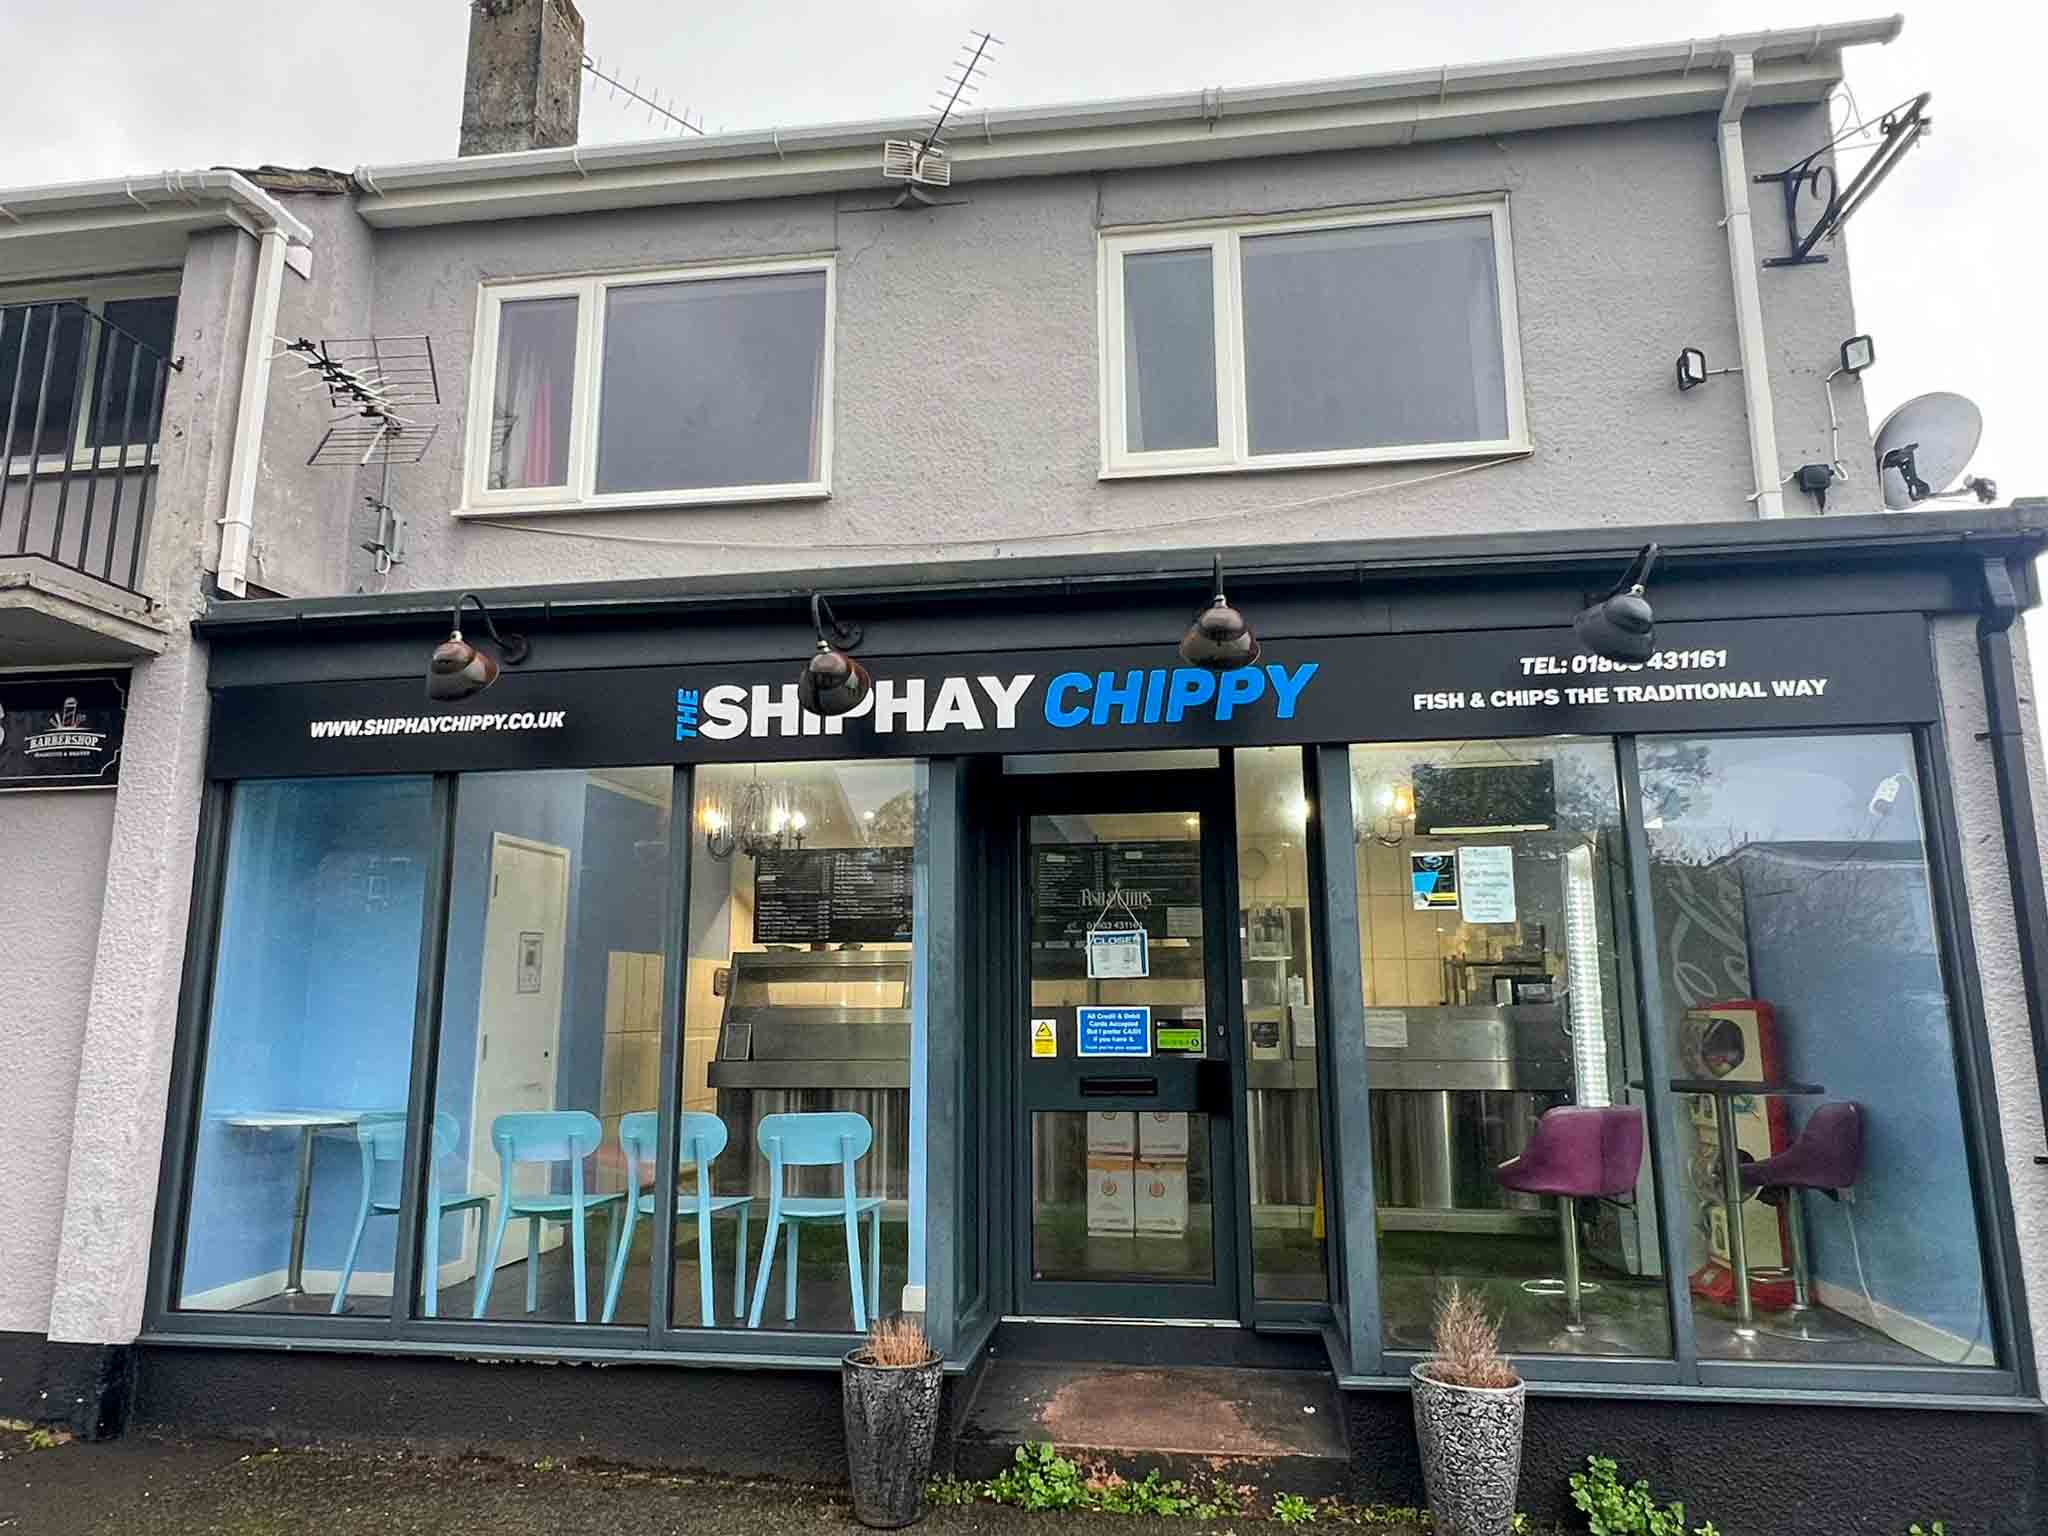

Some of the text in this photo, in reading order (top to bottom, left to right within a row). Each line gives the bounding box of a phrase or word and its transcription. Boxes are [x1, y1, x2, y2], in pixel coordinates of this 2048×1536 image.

[1519, 656, 1568, 676] TEL:
[1646, 649, 1729, 671] 431161
[675, 687, 700, 741] THE
[1042, 663, 1319, 729] CHIPPY
[1413, 678, 1828, 711] FISH & CHIPS THE TRADITIONAL WAY
[310, 711, 566, 738] WWW.SHIPHAYCHIPPY.CO.UK
[30, 735, 99, 749] BARBERSHOP
